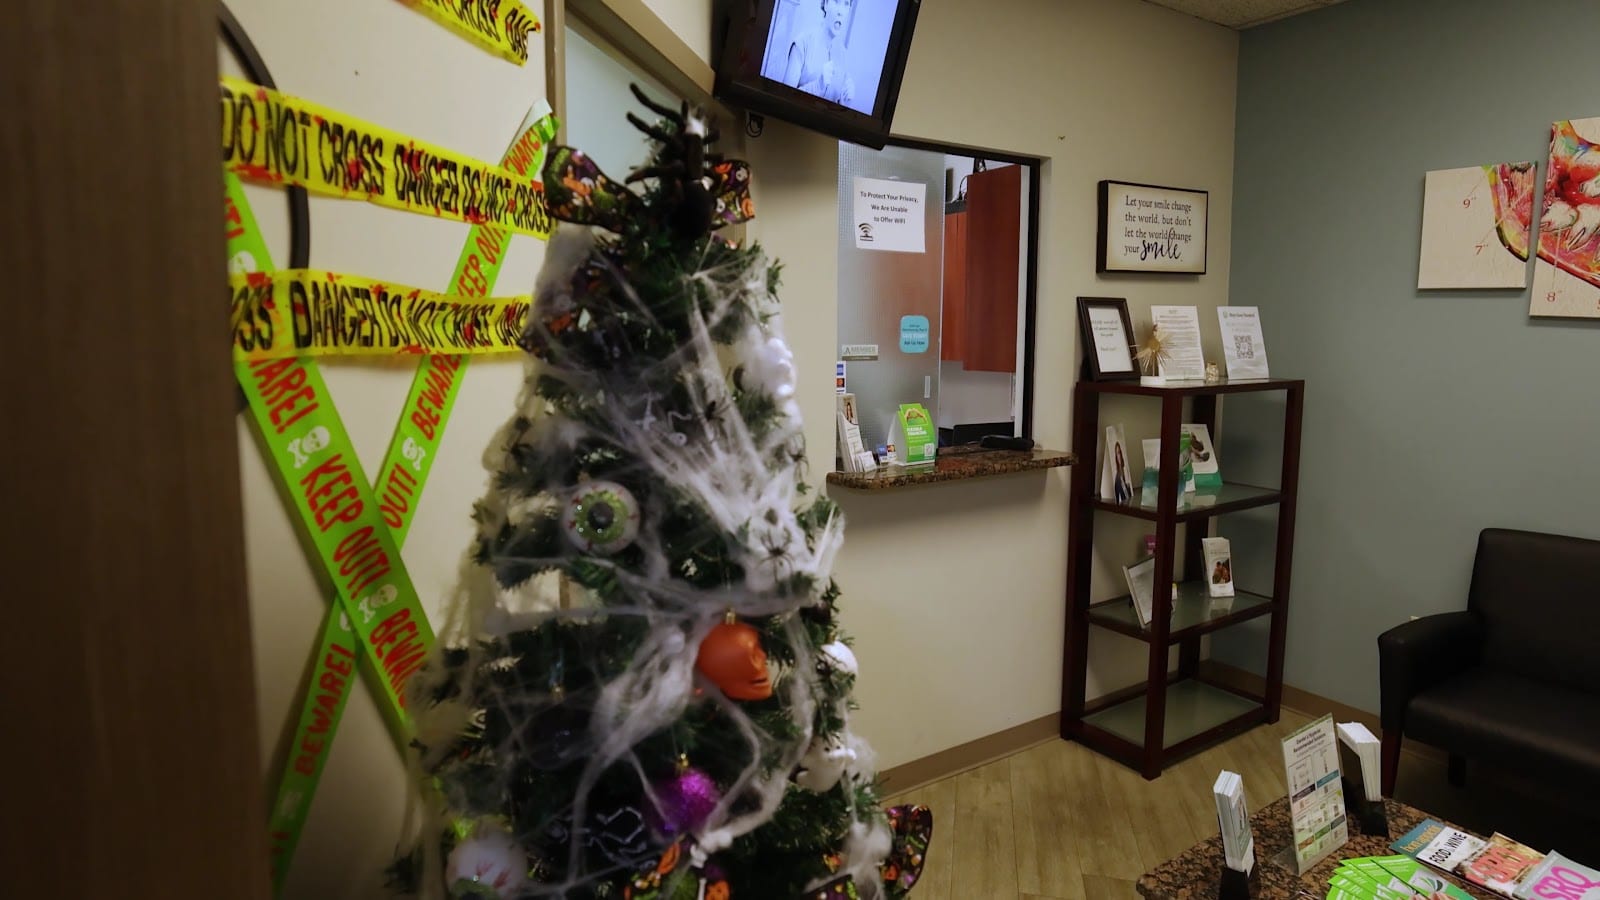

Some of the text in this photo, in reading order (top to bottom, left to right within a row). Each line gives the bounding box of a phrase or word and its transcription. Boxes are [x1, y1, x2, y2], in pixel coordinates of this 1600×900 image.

[222, 87, 256, 161] DO
[263, 100, 312, 180] NOT
[318, 118, 385, 196] CROSS
[393, 143, 459, 214] DANGER
[462, 165, 483, 217] DO
[484, 171, 511, 225] NOT
[860, 190, 867, 198] To
[867, 192, 886, 200] Protect
[886, 193, 898, 201] Your
[1125, 195, 1192, 215] Let your smile change
[1124, 227, 1192, 244] let the world change
[1125, 212, 1192, 226] the world, but don't
[1124, 244, 1140, 257] your
[289, 280, 384, 348] DANGER
[378, 291, 411, 347] DO
[407, 297, 449, 353] NOT
[443, 303, 495, 349] CROSS
[249, 356, 319, 434] ARE!
[300, 454, 391, 600] KEEP OUT!
[295, 643, 356, 776] BEWARE!
[1429, 848, 1452, 864] FOOD
[1443, 832, 1467, 849] WINE
[1532, 866, 1600, 900] SRQ
